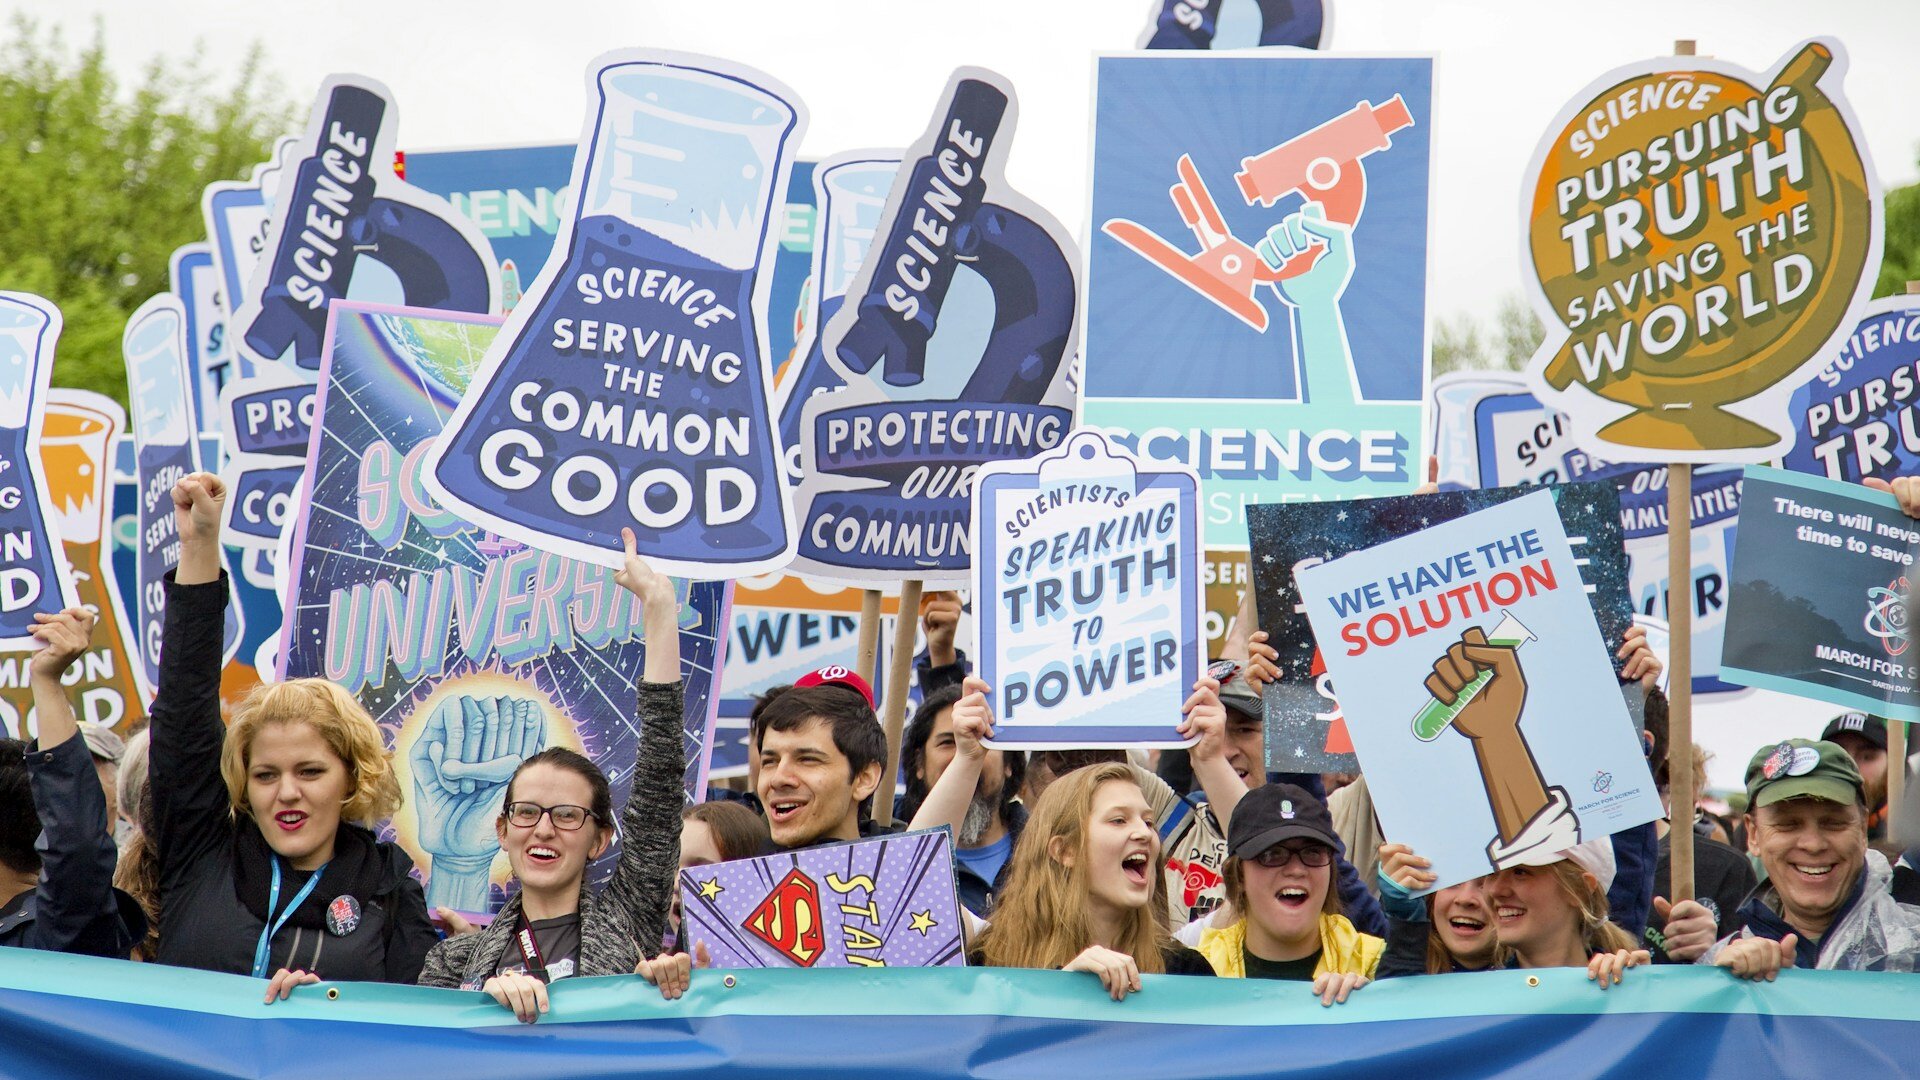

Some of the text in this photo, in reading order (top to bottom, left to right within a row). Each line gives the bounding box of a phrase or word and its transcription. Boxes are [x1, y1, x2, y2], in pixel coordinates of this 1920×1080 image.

[1557, 86, 1800, 216] PURSUING
[1569, 80, 1721, 160] SCIENCE
[286, 121, 367, 309] SCIENCE
[885, 119, 984, 321] SCIENCE
[1562, 127, 1804, 275] TRUTH
[577, 267, 737, 329] SCIENCE
[1568, 203, 1811, 329] SAVING THE
[552, 318, 742, 383] SERVING
[1573, 253, 1814, 384] WORLD
[603, 362, 664, 399] THE
[509, 381, 750, 457] COMMON
[828, 410, 1061, 453] PROTECTING
[480, 429, 757, 528] GOOD
[1006, 484, 1130, 539] SCIENTISTS
[1632, 471, 1668, 495] OU
[1004, 502, 1177, 578] SPEAKING
[1773, 497, 1920, 545] There will neve
[1796, 525, 1913, 566] time to save
[1003, 543, 1177, 625] TRUTH
[1328, 582, 1385, 618] WE
[1388, 551, 1477, 600] HAVE
[1477, 529, 1544, 569] THE
[1341, 559, 1558, 656] SOLUTION
[1073, 616, 1104, 645] TO
[1816, 645, 1871, 671] MARCH
[1873, 659, 1903, 678] FOR
[1005, 639, 1177, 719] POWER
[1872, 680, 1894, 691] EARTH
[1579, 801, 1600, 811] MARCH
[1615, 789, 1640, 799] SCIENCE
[824, 872, 886, 966] STA
